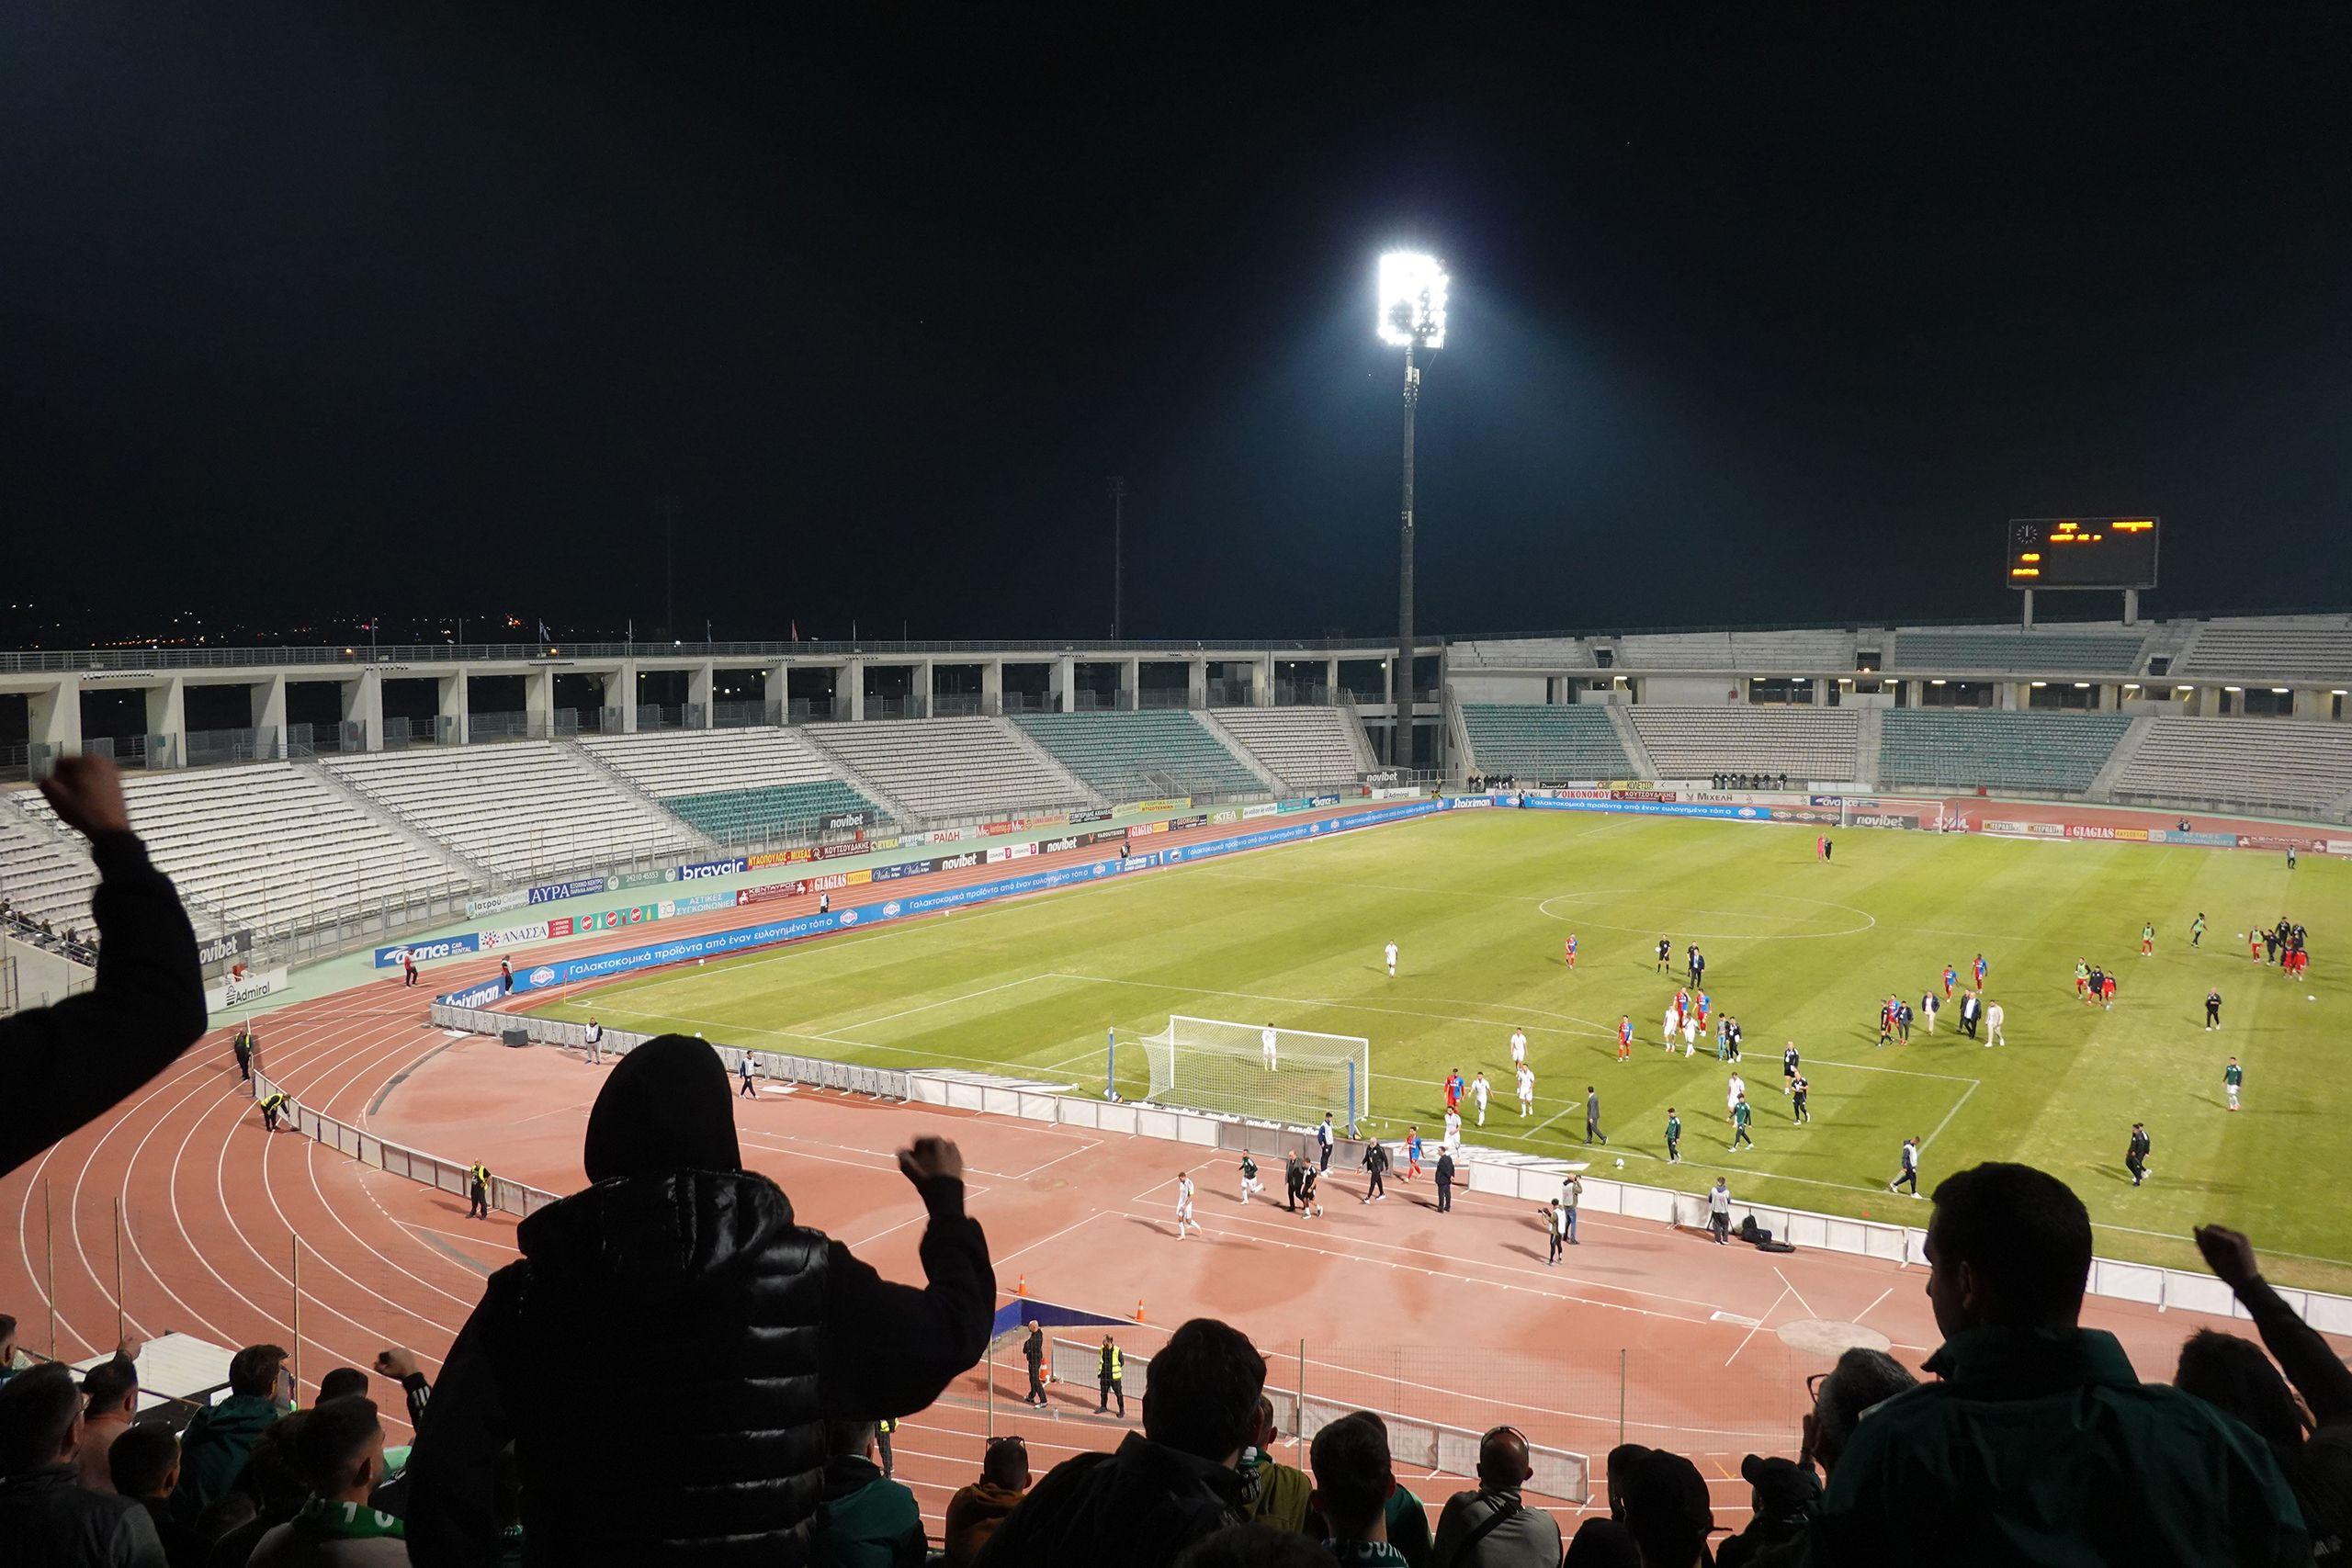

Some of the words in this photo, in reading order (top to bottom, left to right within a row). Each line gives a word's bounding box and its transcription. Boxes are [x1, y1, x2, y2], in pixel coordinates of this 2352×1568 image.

[1367, 771, 1398, 781] novibet
[1389, 791, 1409, 799] Admiral
[1562, 790, 1610, 799] ΟΙΚΟΝΟΜΟΥ
[1453, 797, 1490, 809] Stoiximan
[1532, 799, 1585, 807] Γαλακτοκομικά
[1587, 801, 1622, 809] προϊόντα
[1661, 806, 1707, 815] ευλογημένο
[831, 813, 864, 829] novibet
[1855, 814, 1905, 827] novibet
[1132, 823, 1153, 837] GIAGIAS
[2073, 826, 2115, 839] GIAGIAS
[824, 840, 870, 854] ΚΟΥΤΣΟΥΔΑΚΗΣ
[1047, 836, 1078, 852] novibet
[1187, 843, 1224, 855] Γαλακτοκομικά
[790, 848, 811, 860] ΜΙΧΕΑΣ
[942, 852, 978, 871] novibet
[683, 858, 744, 881] bravair
[626, 873, 642, 883] 24210
[643, 871, 659, 881] 45553
[814, 873, 848, 892] GIAGIAS
[532, 884, 571, 904] ΑΥΡΑ
[748, 882, 797, 895] ΚΕΝΤΑΥΡΟΣ
[910, 893, 965, 909] Γαλακτοκομικά
[966, 885, 999, 899] προϊόντα
[1000, 883, 1015, 892] από
[1015, 879, 1032, 889] έναν
[1032, 872, 1070, 886] ευλογημένο
[474, 896, 502, 911] Ιατρού
[689, 894, 722, 906] ΑΣΤΙΚΕΣ
[676, 900, 736, 916] ΣΥΓΚΟΙΝΩΝΙΕΣ
[501, 926, 548, 943] ΑΝΑΣΣΑ
[198, 935, 239, 965] ovibet
[451, 941, 463, 950] CAR
[451, 946, 472, 956] RENTAL
[569, 950, 651, 976] Γαλακτοκομικά
[654, 942, 703, 961] προϊόντα
[706, 937, 727, 950] από
[729, 932, 752, 945] έναν
[753, 922, 808, 941] ευλογημένο
[395, 942, 449, 965] aance
[235, 980, 271, 1004] Admiral
